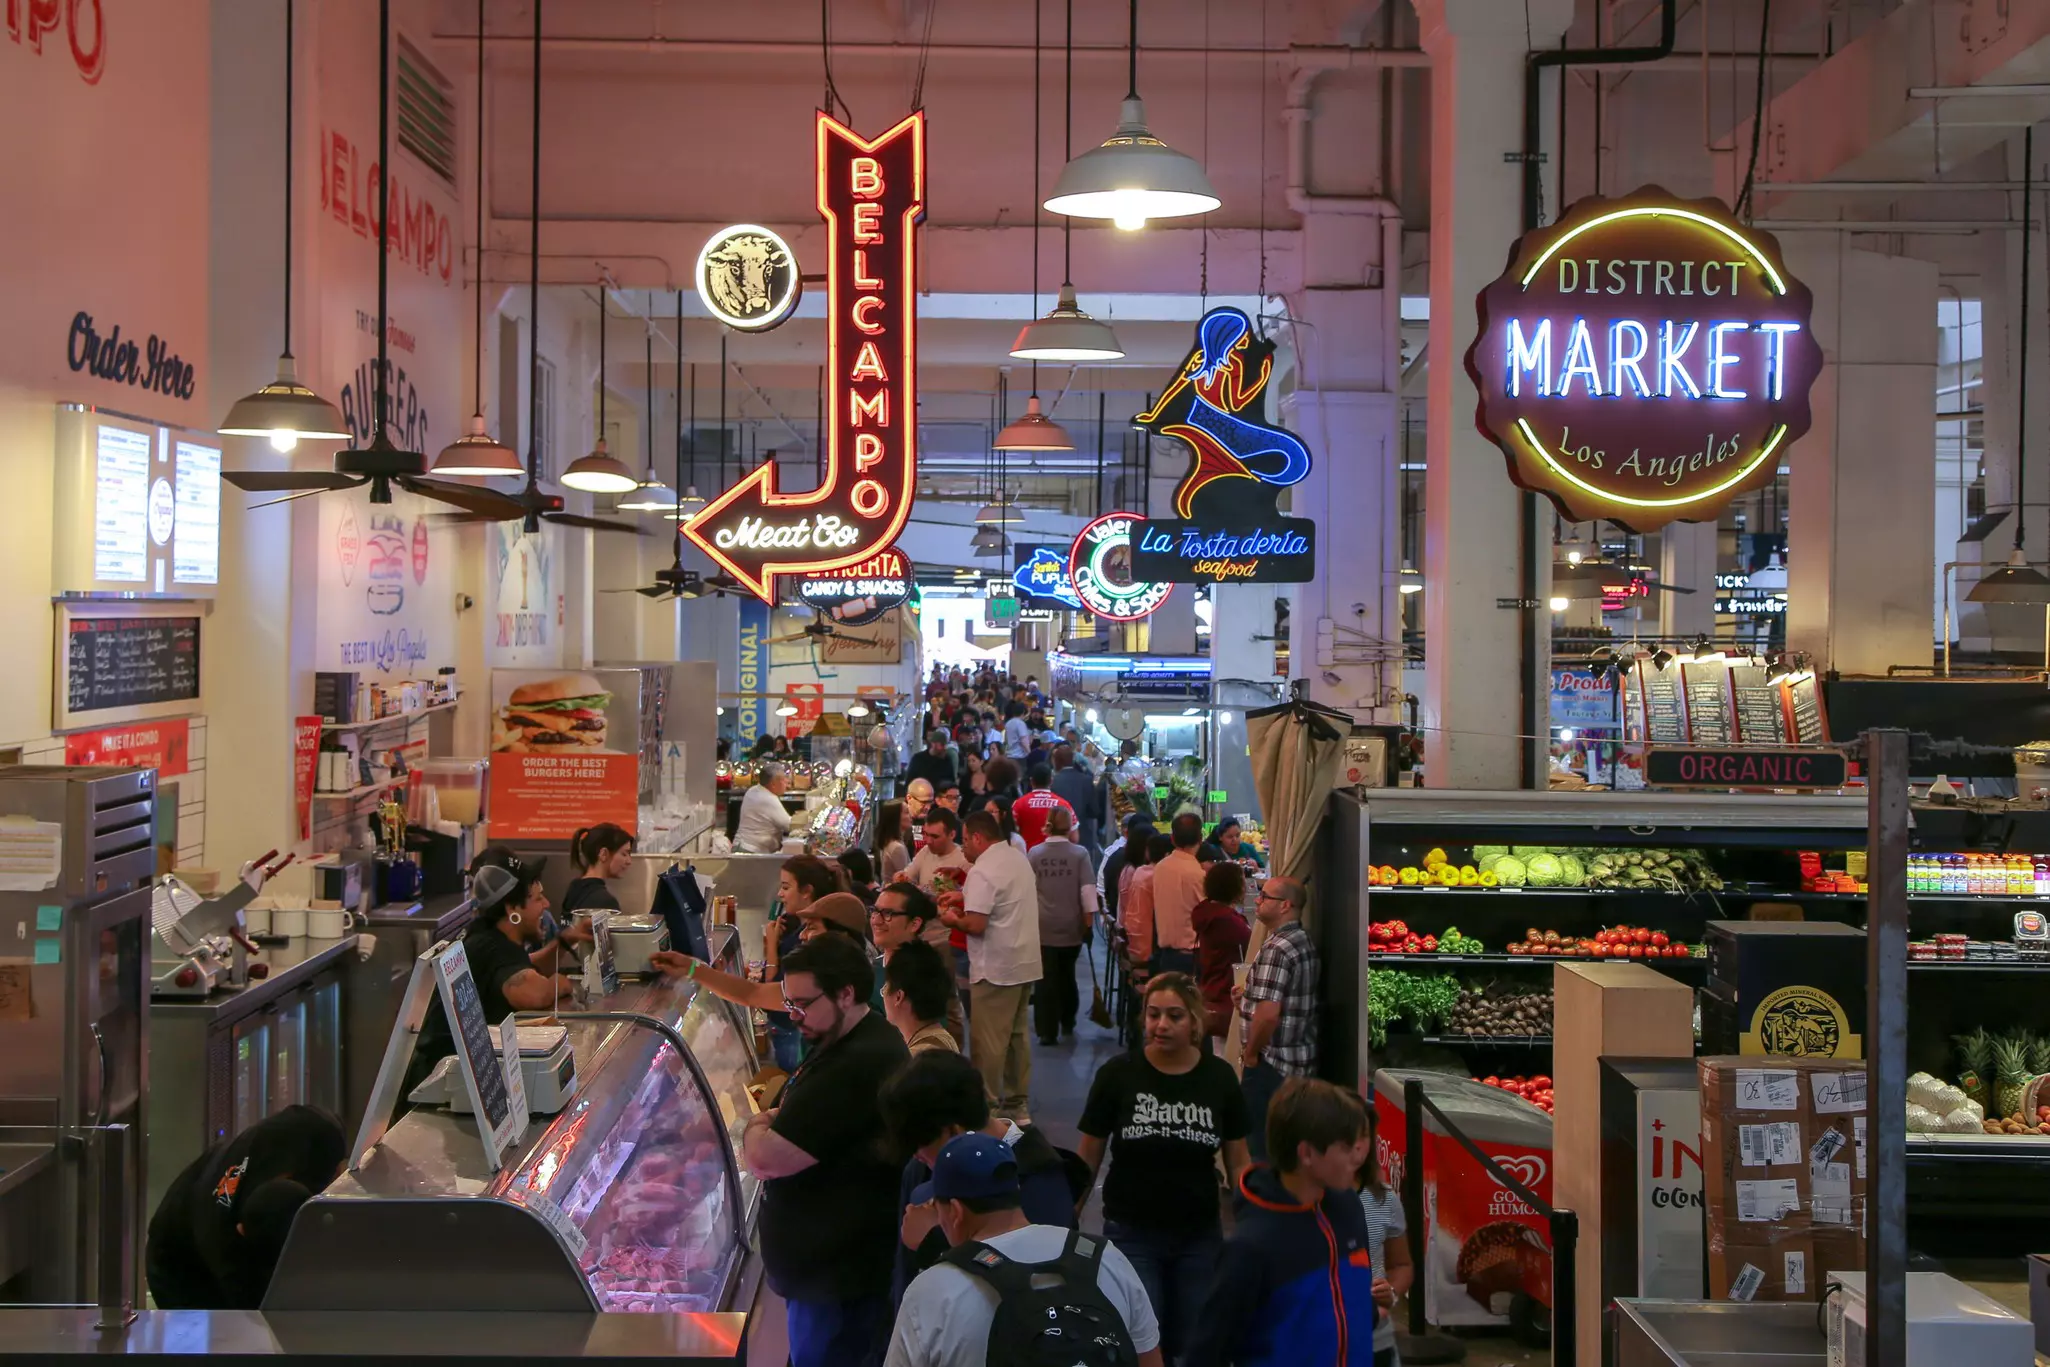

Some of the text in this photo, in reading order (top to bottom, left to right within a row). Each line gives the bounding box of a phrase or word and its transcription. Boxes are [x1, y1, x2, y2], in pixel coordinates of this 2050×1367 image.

[1558, 258, 1746, 296] DISTRICT
[850, 157, 890, 519] BELCAMPO
[68, 311, 195, 400] Order Here
[1504, 316, 1801, 402] MARKET
[1559, 426, 1741, 487] Los Angeles
[714, 514, 811, 549] Meat
[1140, 526, 1174, 553] La
[1194, 558, 1259, 581] seafood
[1714, 575, 1750, 588] ICK
[802, 580, 906, 597] CANDY & SNACKS
[1113, 598, 1131, 617] &
[522, 757, 607, 768] ORDER THE BEST
[524, 768, 605, 778] BURGERS HERE!
[1680, 755, 1812, 782] ORGANIC
[1040, 858, 1068, 867] GCM
[1760, 989, 1837, 1012] IMPORTED MINERAL WATER
[1132, 1092, 1214, 1129] Bacon
[1488, 1203, 1541, 1215] HUMO
